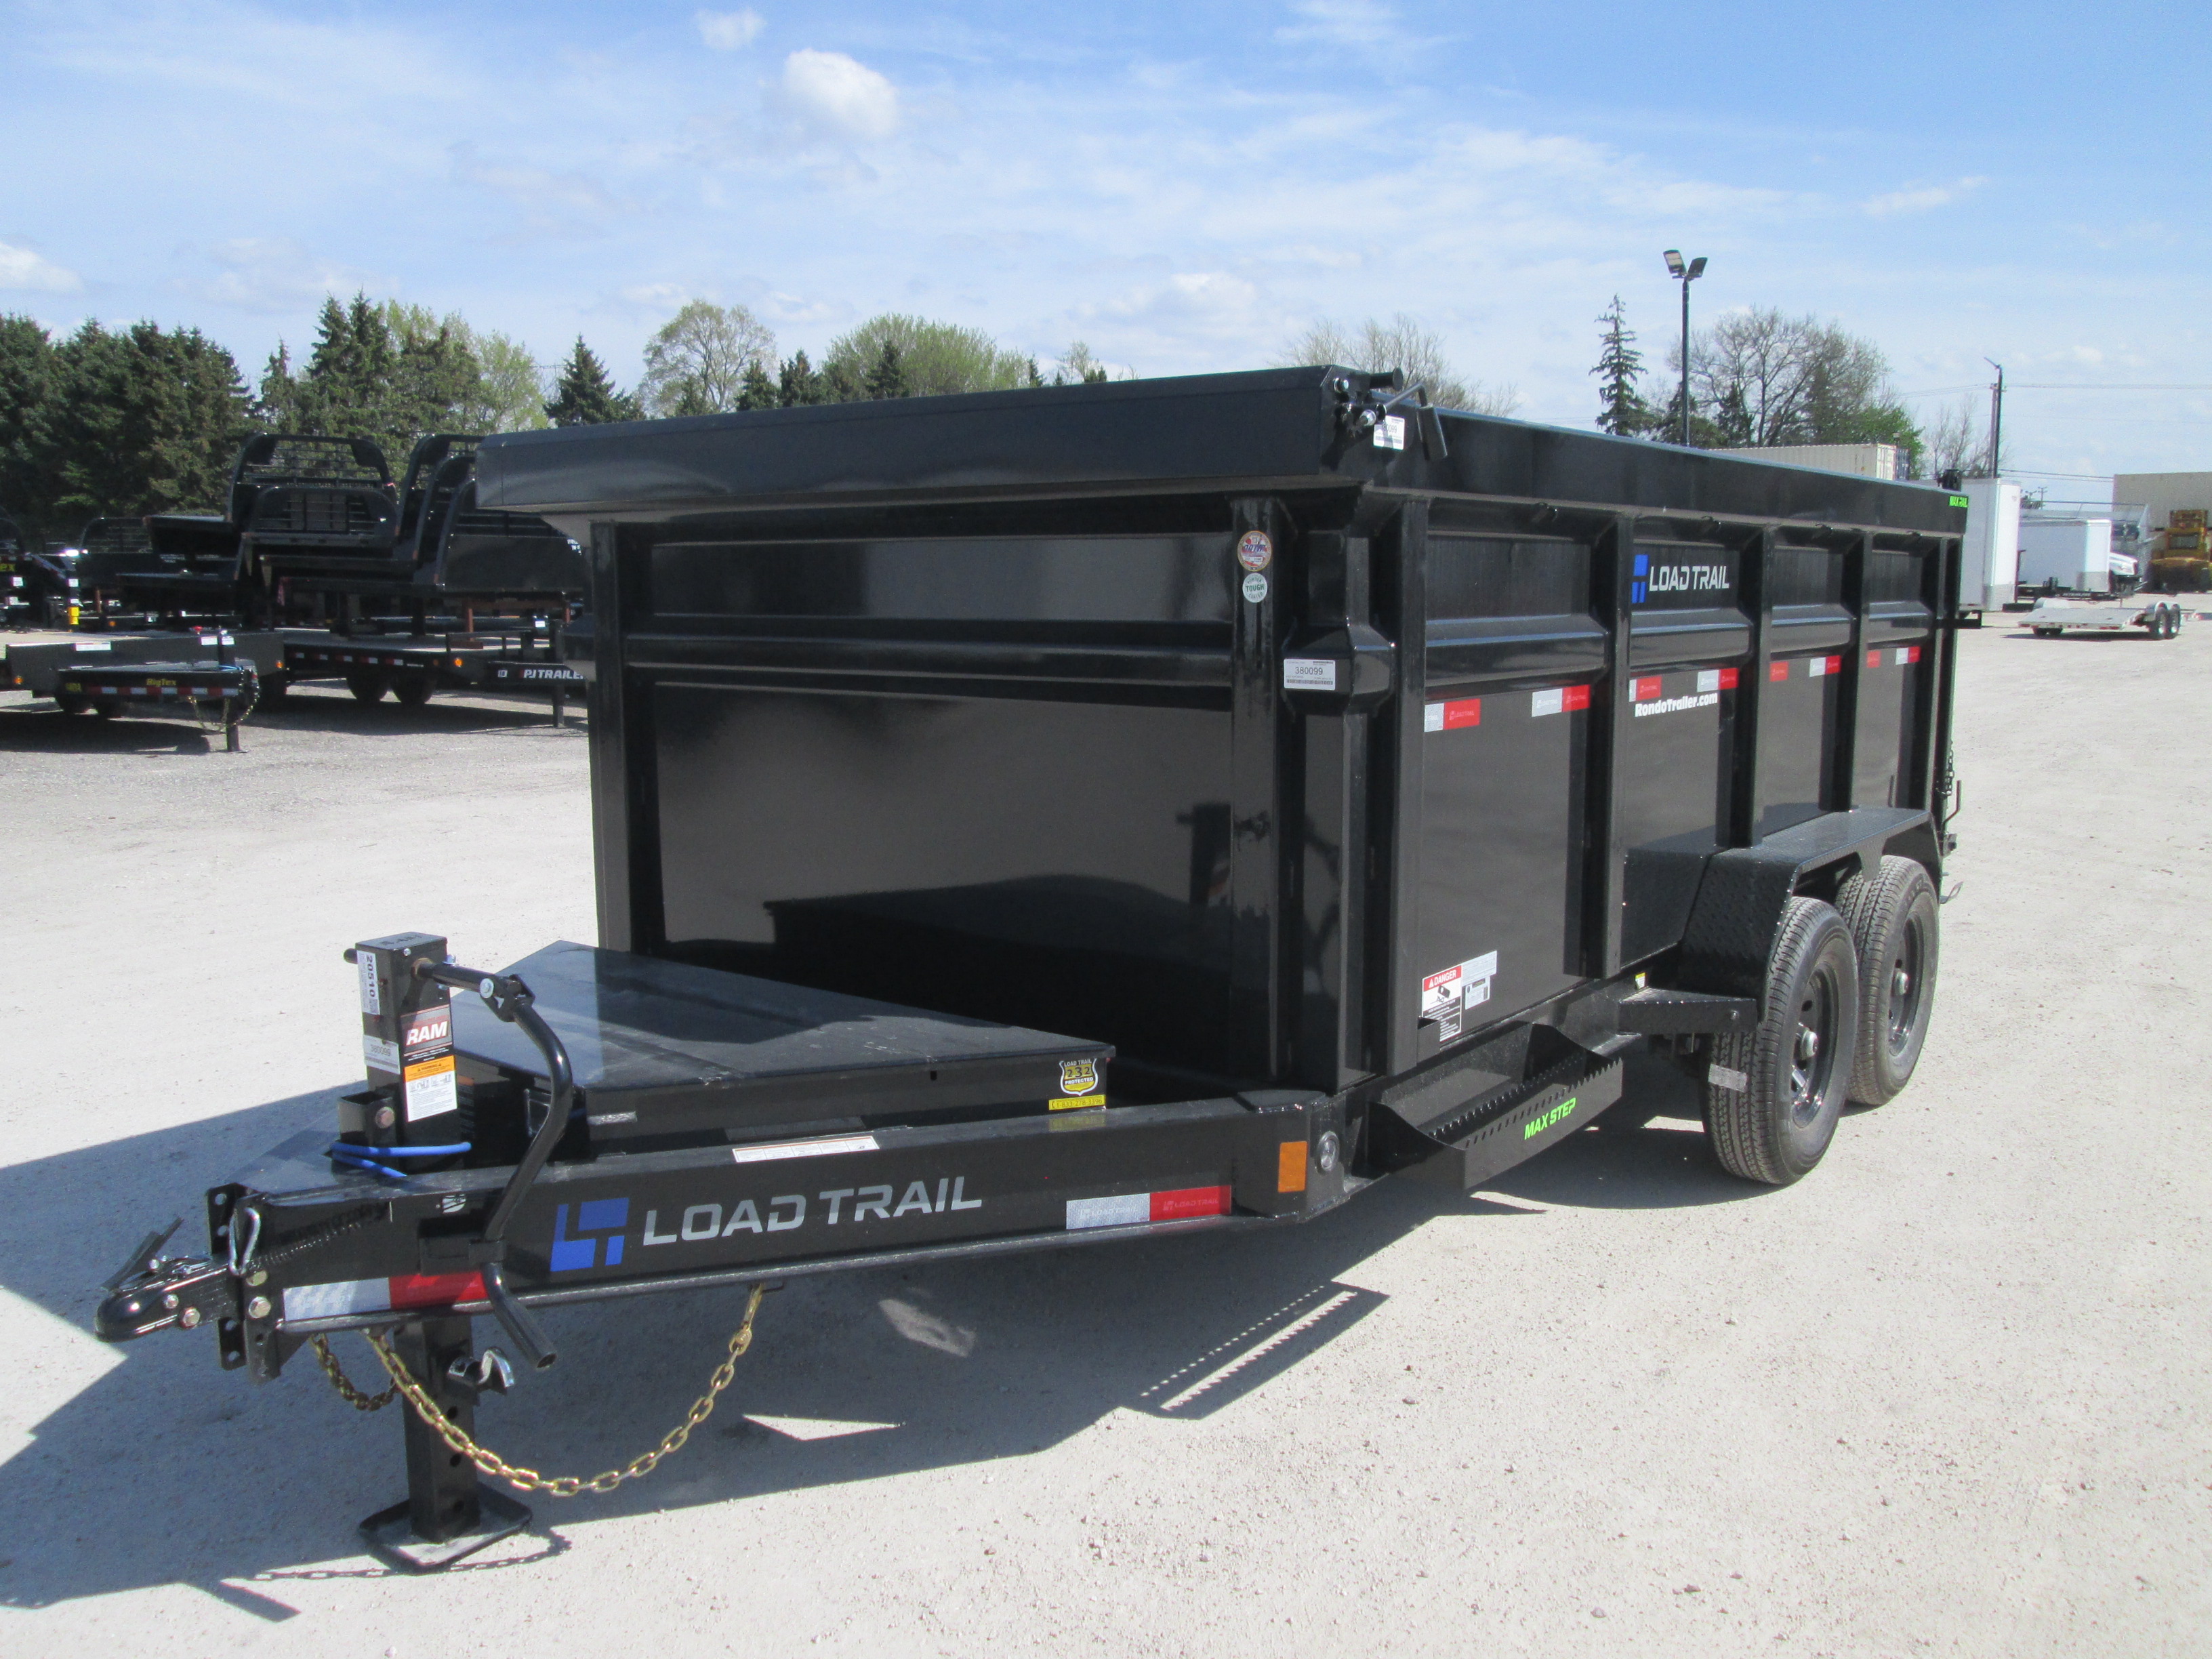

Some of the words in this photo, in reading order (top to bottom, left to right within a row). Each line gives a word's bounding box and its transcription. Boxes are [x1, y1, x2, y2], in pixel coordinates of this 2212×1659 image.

[1245, 583, 1265, 593] TOUGH
[1649, 565, 1690, 592] LOAD
[1692, 565, 1729, 590] TRAIL
[537, 670, 584, 680] TRAILE
[1295, 666, 1323, 676] 380099
[1635, 693, 1718, 718] RondoTrailer.com
[366, 954, 376, 998] 20510
[1433, 969, 1457, 986] DANGER
[406, 1021, 447, 1046] RAM
[1064, 1077, 1094, 1085] PROTECTED
[1524, 1112, 1549, 1140] MAX
[1549, 1097, 1577, 1125] STEP
[642, 1193, 807, 1246] LOAD
[819, 1175, 983, 1225] TRAIL
